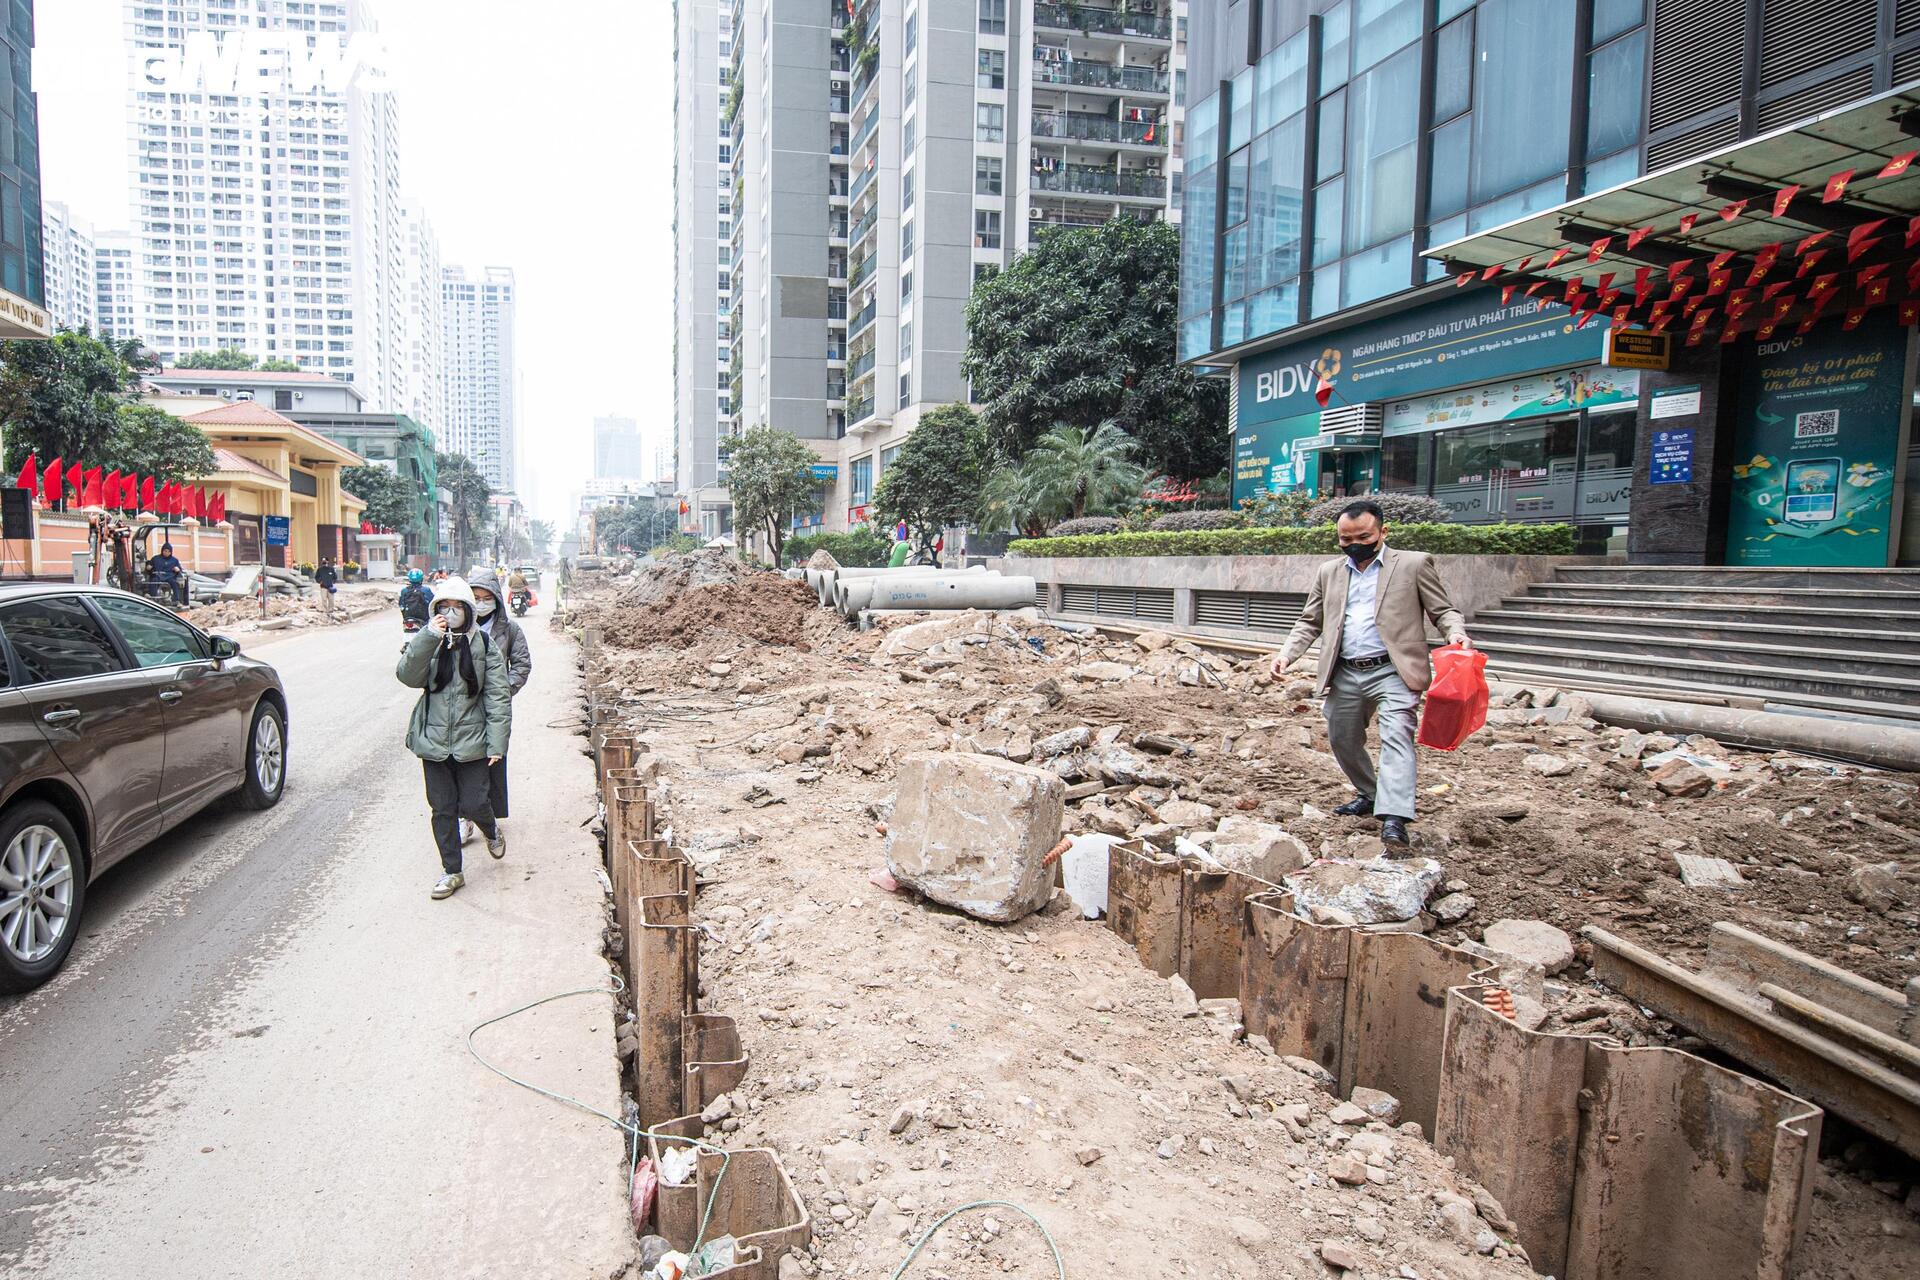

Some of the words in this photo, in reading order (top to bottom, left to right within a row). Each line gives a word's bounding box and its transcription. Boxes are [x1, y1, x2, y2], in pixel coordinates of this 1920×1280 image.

[1352, 344, 1375, 358] NGÂN
[1376, 336, 1400, 352] HÀNG
[1402, 331, 1427, 345] TMCP
[1428, 323, 1447, 339] ĐẦU
[1449, 319, 1463, 333] TƯ
[1464, 315, 1478, 329] VÀ
[1479, 306, 1506, 325] PHÁT
[1618, 336, 1652, 345] WESTERN
[1758, 340, 1790, 355] BIDV
[1802, 361, 1820, 375] ký
[1845, 352, 1882, 368] phút
[1257, 359, 1318, 403] BIDV
[1584, 489, 1620, 504] BIDV
